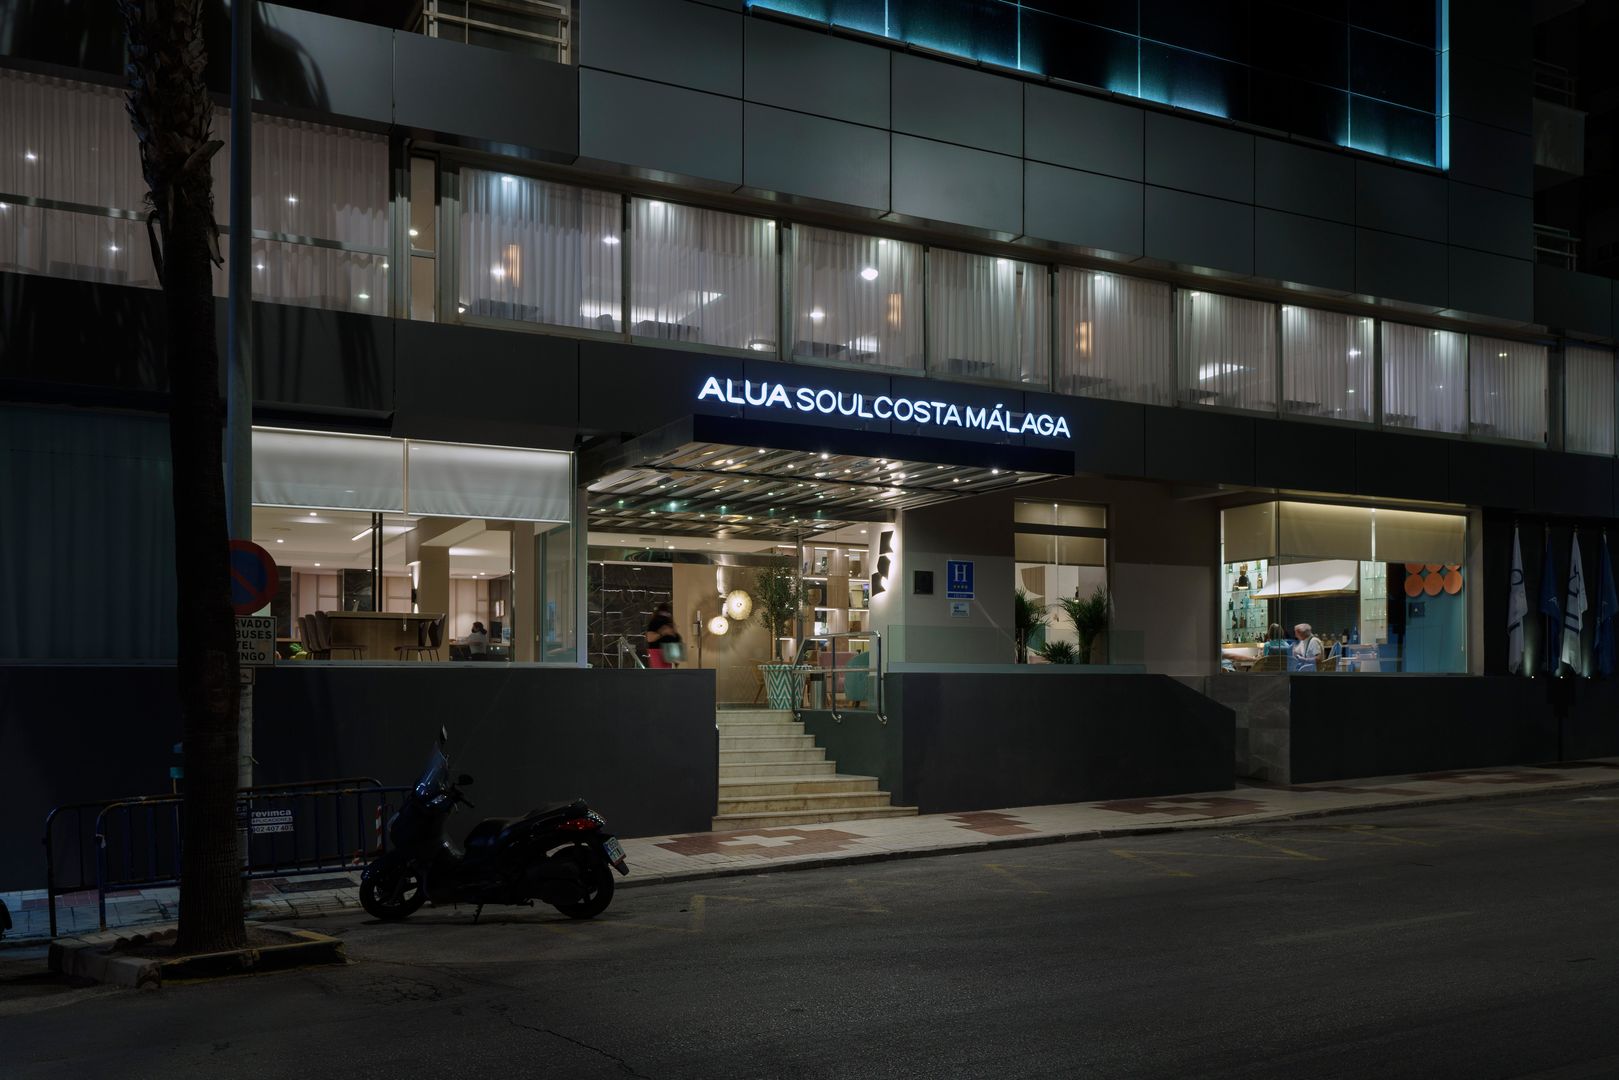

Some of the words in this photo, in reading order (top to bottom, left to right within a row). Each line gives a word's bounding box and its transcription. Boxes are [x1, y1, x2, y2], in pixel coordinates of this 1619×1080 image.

[698, 376, 792, 408] ALUA
[796, 387, 873, 418] SOUL
[873, 395, 962, 428] COSTA
[965, 403, 1072, 438] MÁLAGA
[953, 564, 968, 583] H
[233, 619, 271, 628] RVADO
[234, 630, 272, 639] BUSES
[235, 640, 255, 650] TEL
[241, 652, 266, 661] NGO
